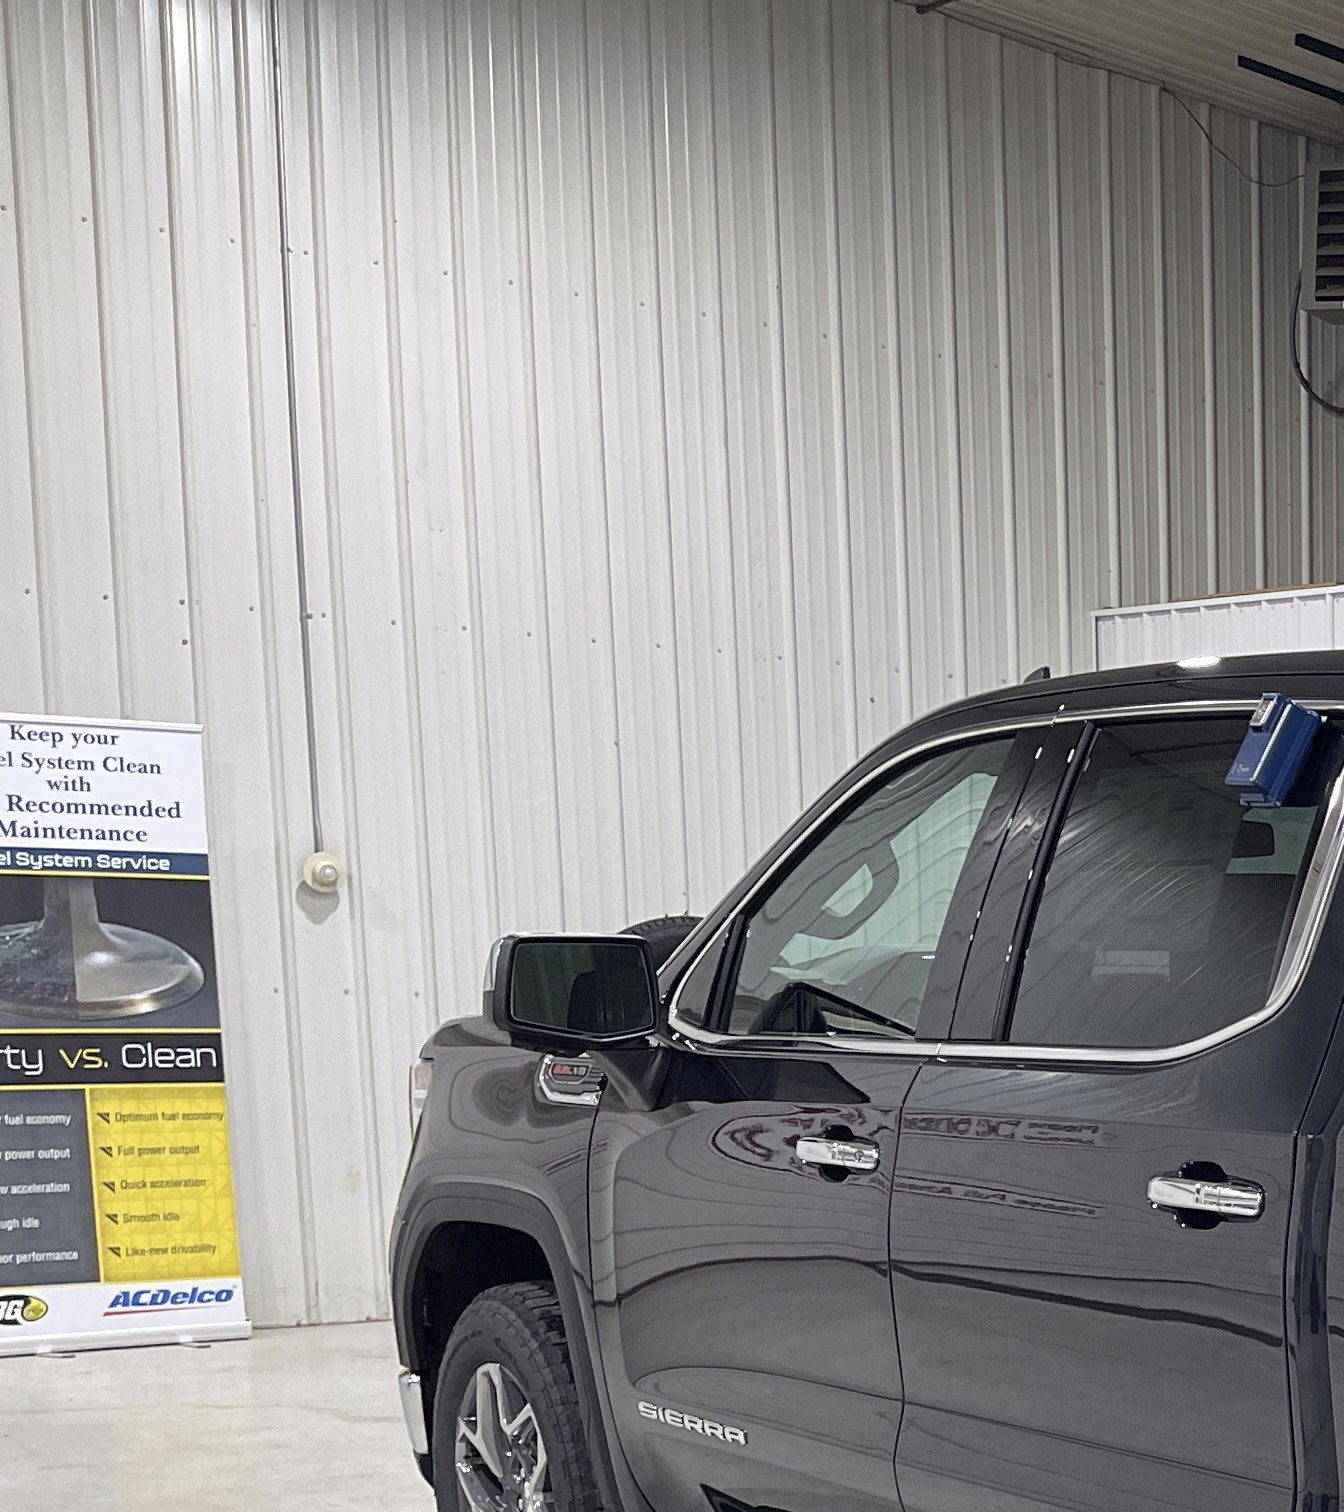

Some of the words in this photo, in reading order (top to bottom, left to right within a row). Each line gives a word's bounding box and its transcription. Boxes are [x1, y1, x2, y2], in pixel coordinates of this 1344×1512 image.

[9, 724, 64, 749] Keep
[71, 729, 120, 749] your
[21, 752, 95, 774] System
[103, 756, 162, 775] Clean
[47, 776, 91, 792] with
[6, 794, 182, 819] Recommended
[0, 820, 149, 843] Maintenance
[16, 852, 92, 870] System
[97, 854, 171, 870] Service
[60, 1048, 109, 1069] vs.
[122, 1042, 217, 1068] Clean
[4, 1114, 24, 1126] fuel
[26, 1114, 71, 1127] economy
[115, 1111, 158, 1124] Optimum
[161, 1110, 179, 1122] fuel
[182, 1111, 224, 1123] economy
[5, 1150, 35, 1161] power
[117, 1145, 133, 1156] Full
[136, 1146, 166, 1158] power
[120, 1178, 147, 1191] Quick
[22, 1217, 40, 1228] idle
[123, 1212, 161, 1224] Smooth
[163, 1212, 180, 1222] idle
[16, 1251, 78, 1265] performance
[108, 1287, 234, 1308] ACDelco
[638, 1401, 748, 1445] SIERRA
